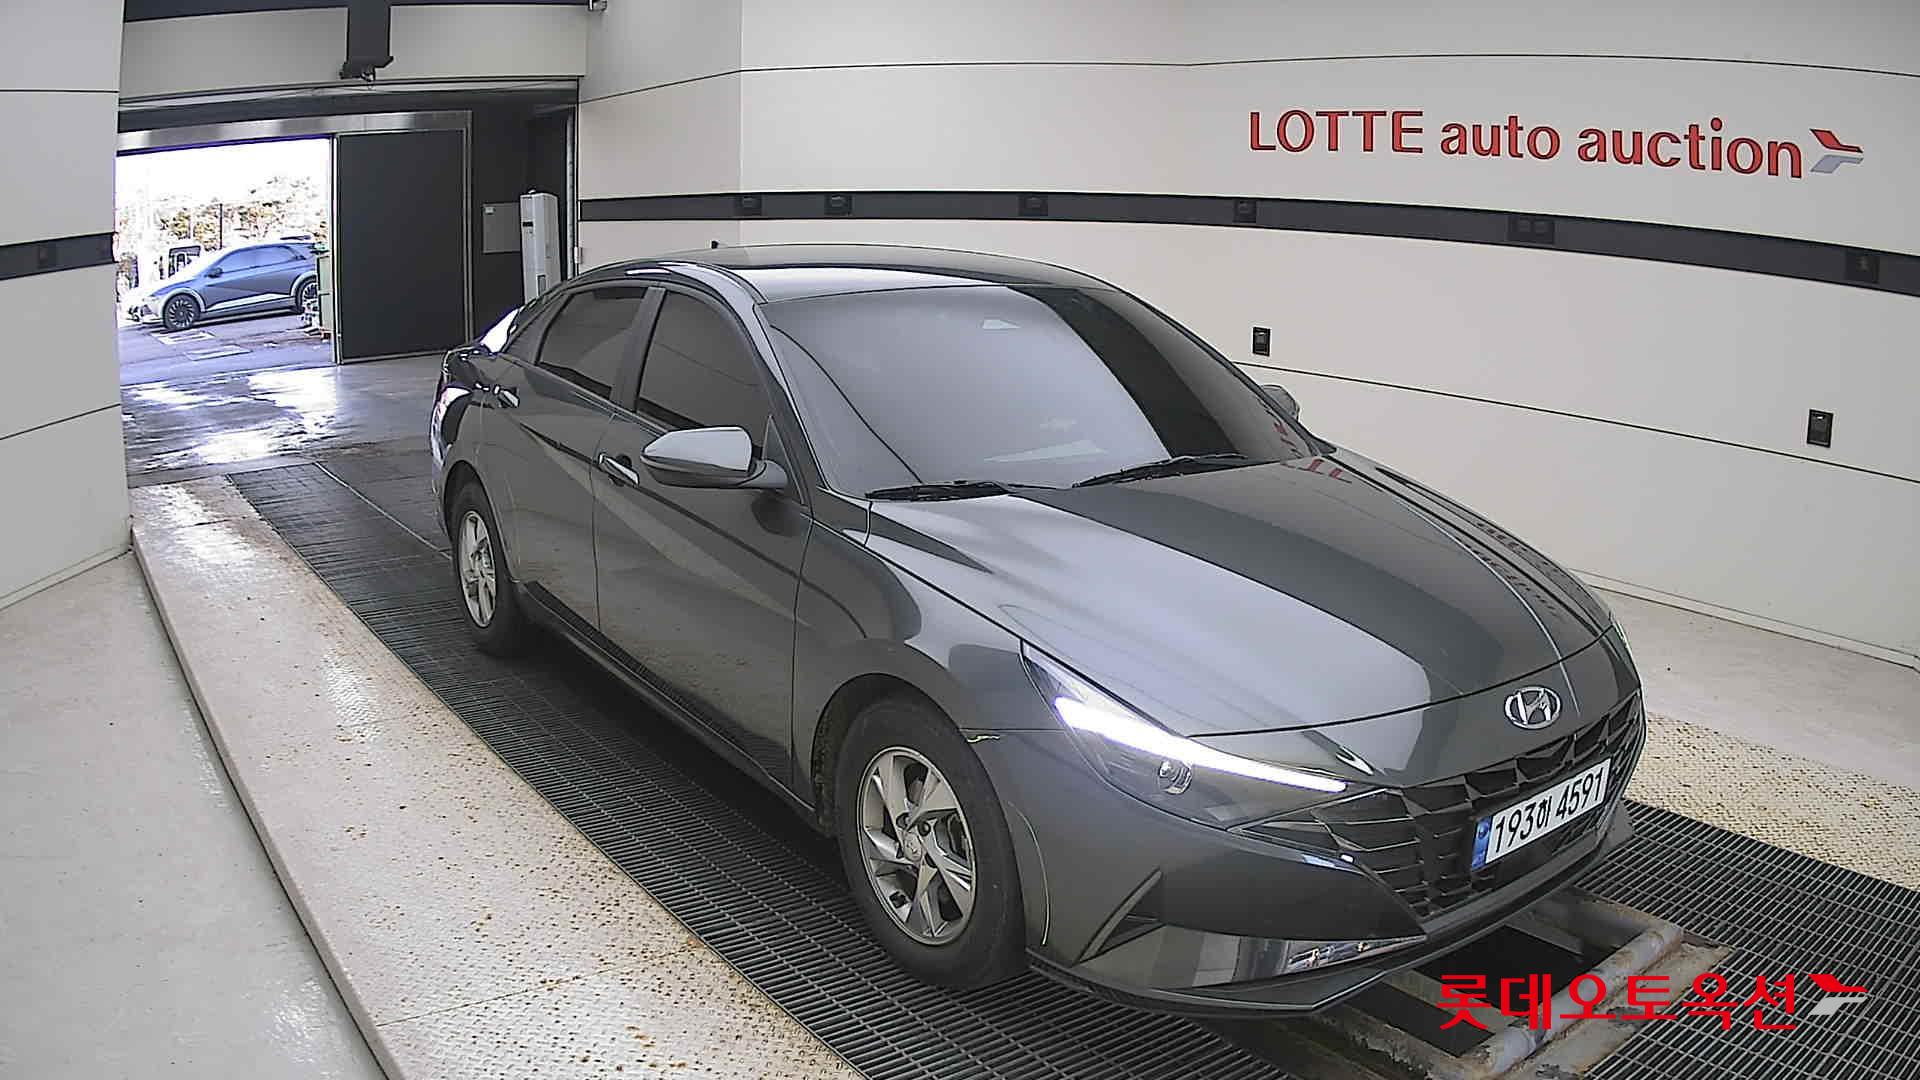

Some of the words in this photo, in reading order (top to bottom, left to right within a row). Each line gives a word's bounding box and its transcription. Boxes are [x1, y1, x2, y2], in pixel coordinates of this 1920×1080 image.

[1249, 110, 1424, 154] LOTTE
[1440, 115, 1561, 160] auto
[1578, 118, 1803, 179] auction
[1556, 767, 1604, 819] 4591
